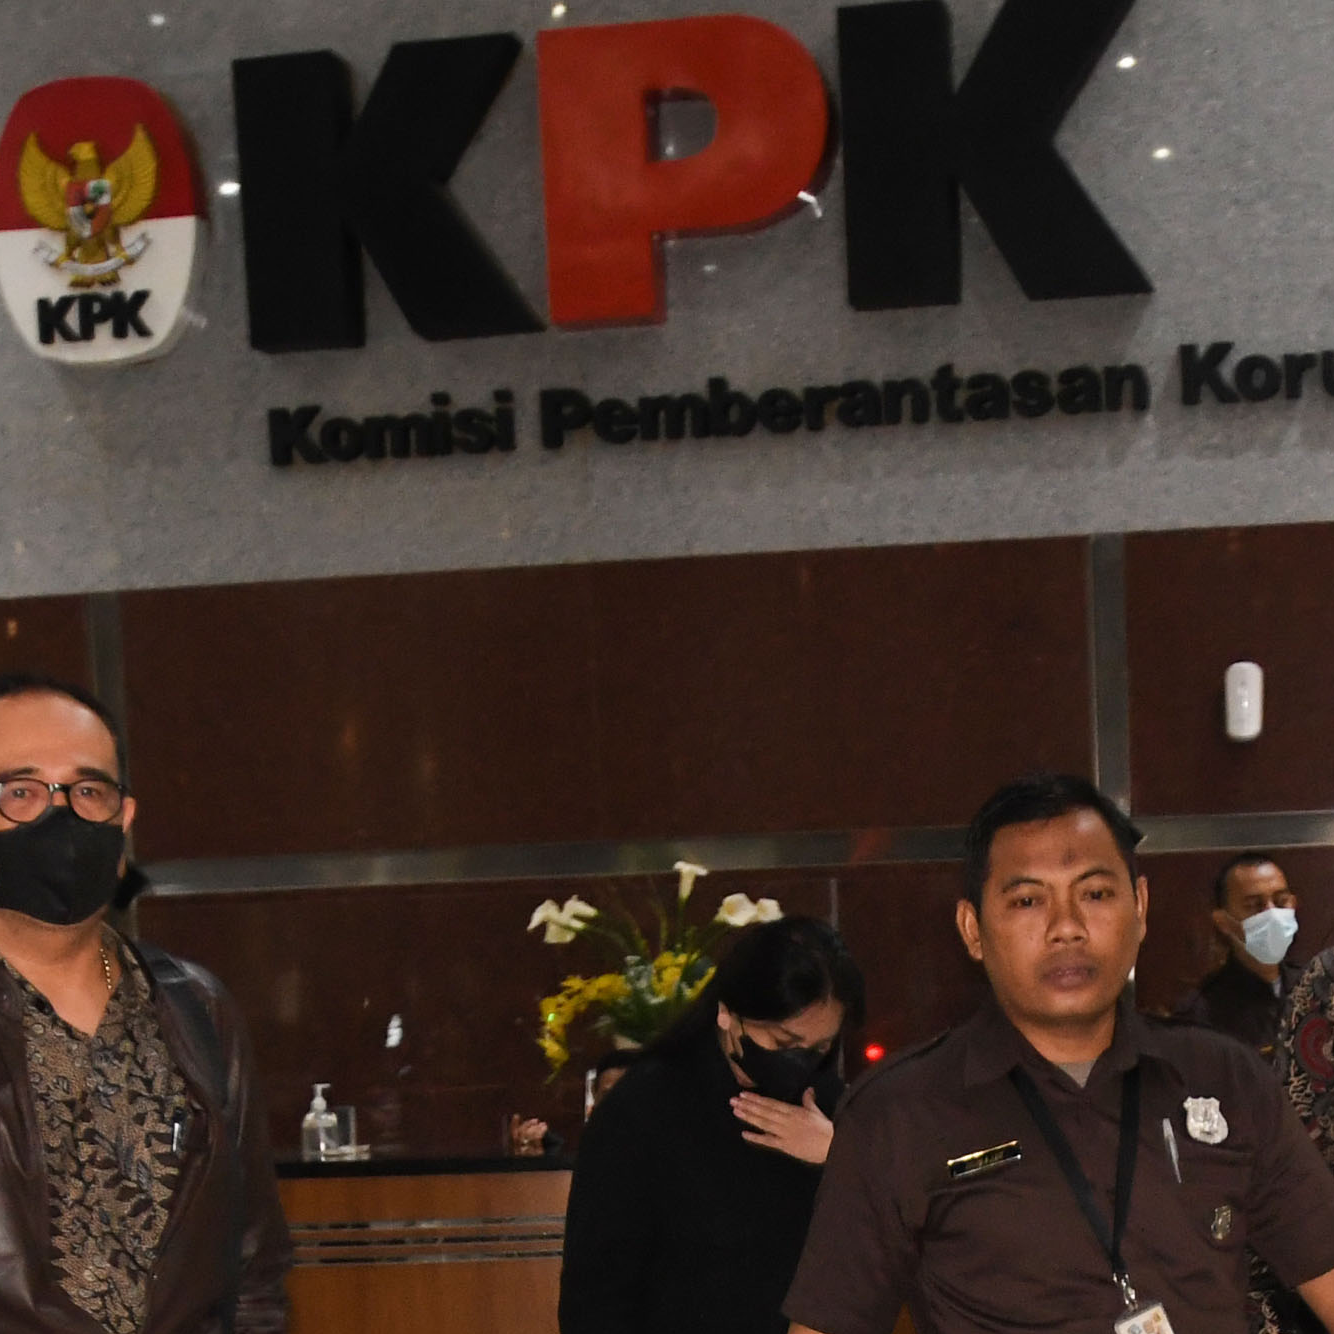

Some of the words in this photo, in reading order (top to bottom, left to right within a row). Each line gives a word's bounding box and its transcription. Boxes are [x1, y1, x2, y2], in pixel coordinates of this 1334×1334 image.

[231, 0, 1156, 354] KPK
[36, 287, 154, 345] KPK
[268, 389, 517, 467] Komisi
[539, 361, 1151, 450] Pemberantasan
